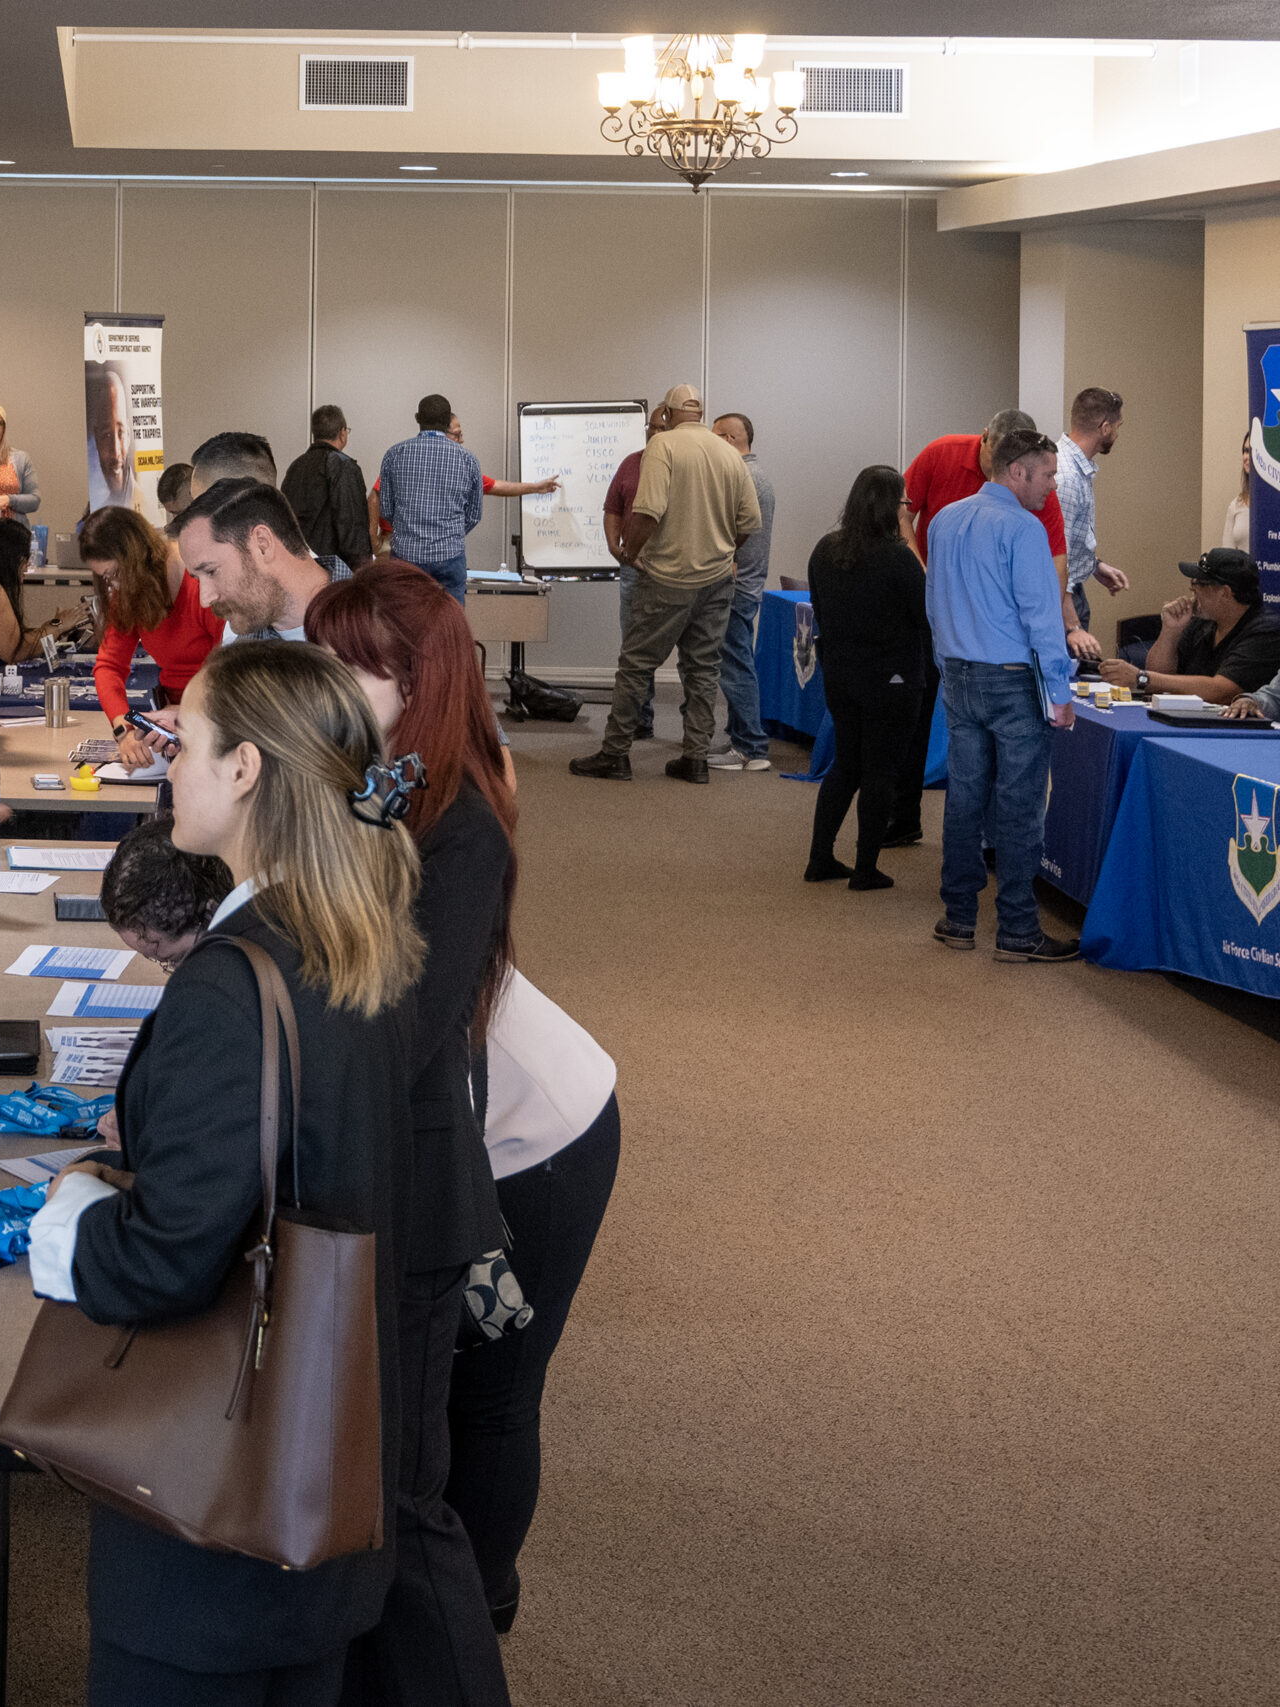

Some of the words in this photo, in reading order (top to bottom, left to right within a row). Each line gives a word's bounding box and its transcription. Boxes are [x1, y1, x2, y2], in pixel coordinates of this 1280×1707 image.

[131, 384, 156, 395] SUPPORTING
[132, 398, 140, 408] THE
[132, 415, 157, 426] PROTECTING
[133, 429, 141, 440] THE
[586, 449, 614, 458] CISCO
[1230, 942, 1250, 959] Force
[1251, 946, 1274, 966] Civilian
